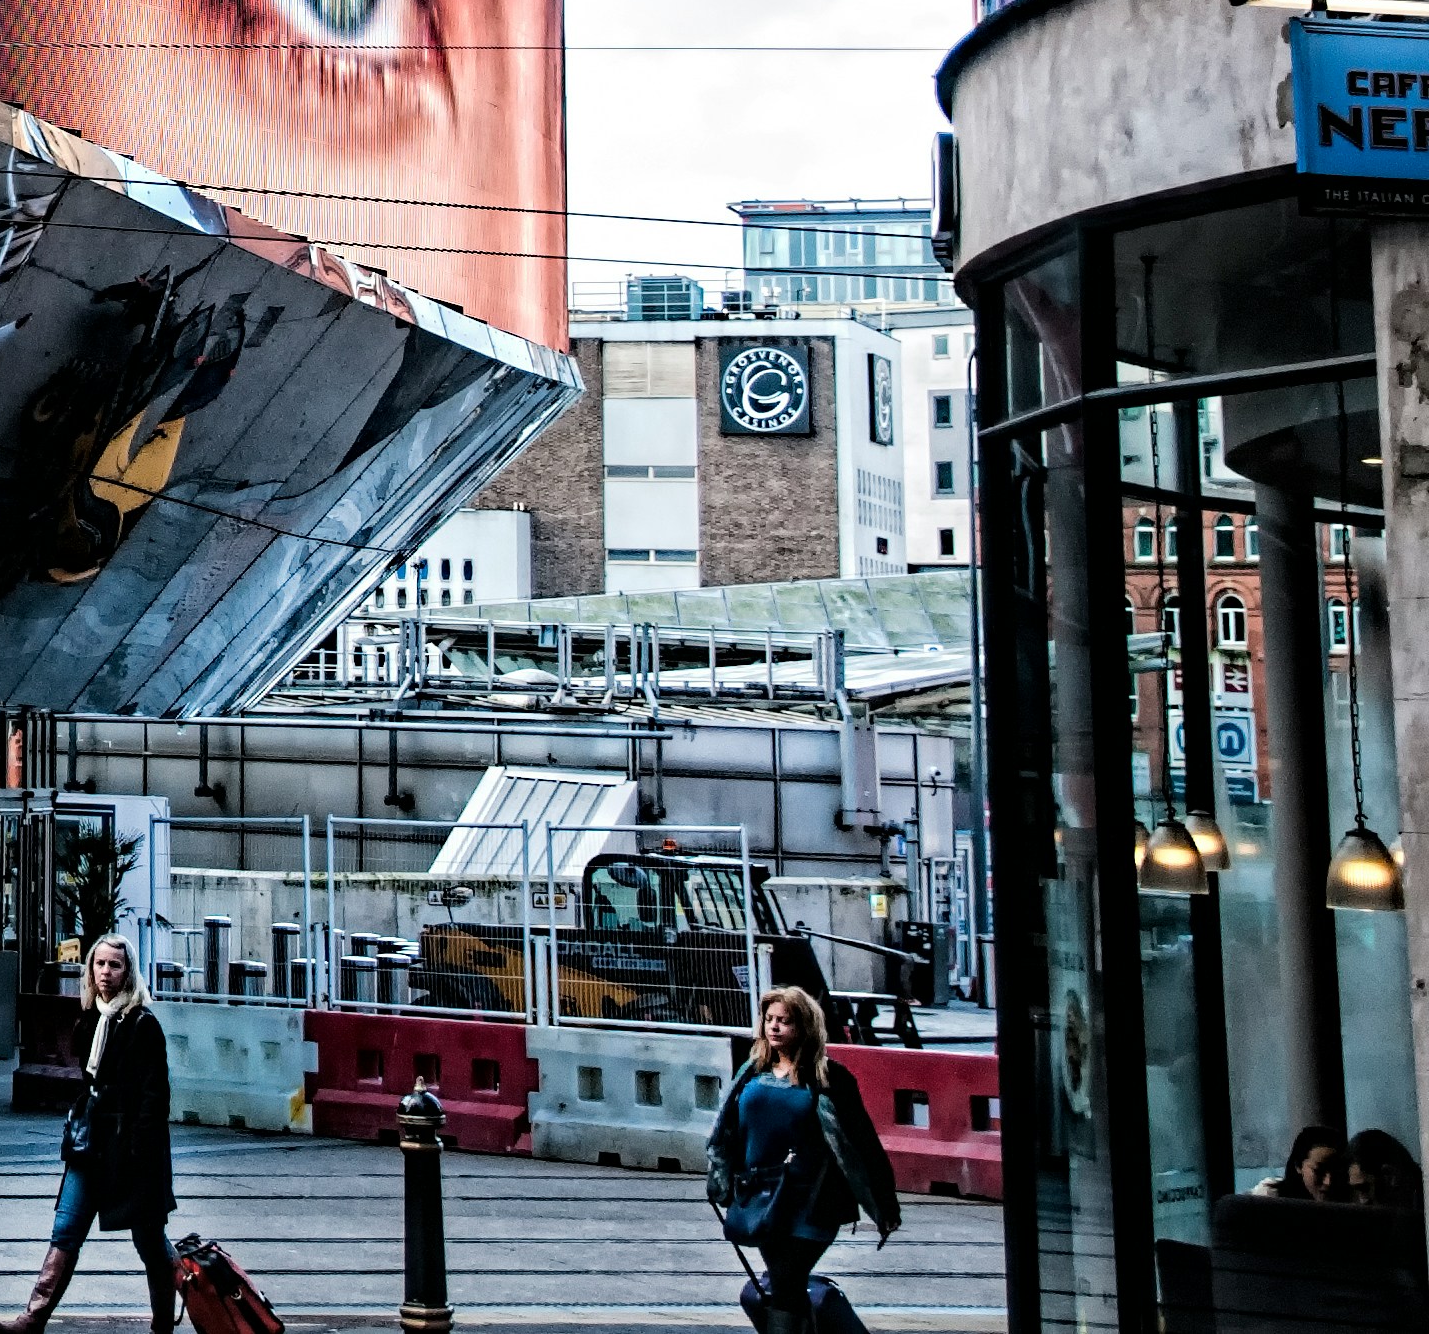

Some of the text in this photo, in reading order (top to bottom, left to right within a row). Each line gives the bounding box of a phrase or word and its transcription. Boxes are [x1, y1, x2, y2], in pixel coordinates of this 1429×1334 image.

[1324, 188, 1350, 201] THE
[1357, 190, 1414, 204] ITALIAN
[725, 351, 803, 384] GROSVENOR
[732, 407, 797, 429] CASINOS
